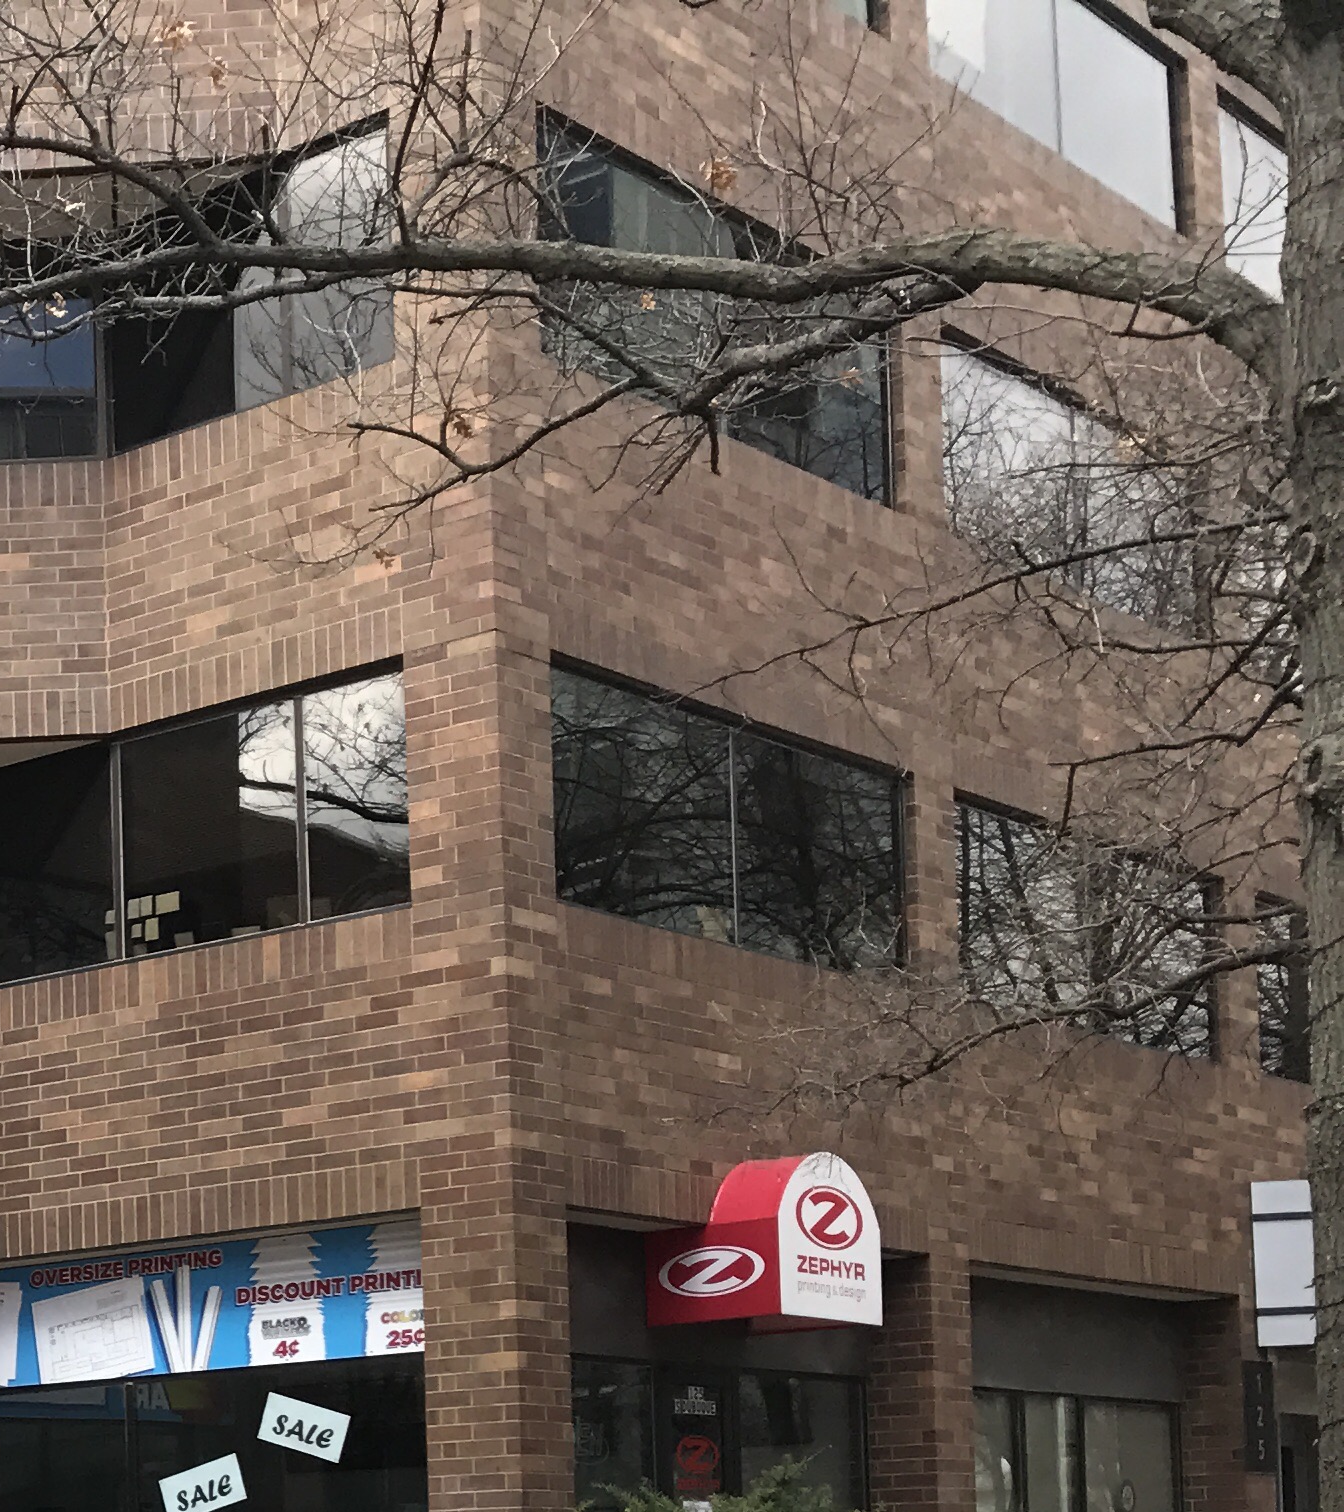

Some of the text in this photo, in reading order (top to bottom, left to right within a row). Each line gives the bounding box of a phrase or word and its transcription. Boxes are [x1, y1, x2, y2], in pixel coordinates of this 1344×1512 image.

[29, 1249, 223, 1288] OVERSIZE PRINTING
[797, 1254, 866, 1281] ZEPHYR
[236, 1276, 346, 1307] DISCOUNT
[797, 1280, 831, 1298] printing
[839, 1284, 867, 1302] design
[261, 1317, 296, 1331] BLACK
[273, 1339, 300, 1359] 4¢
[386, 1328, 425, 1350] 25¢
[272, 1414, 334, 1448] SALE
[176, 1474, 233, 1512] SALE
